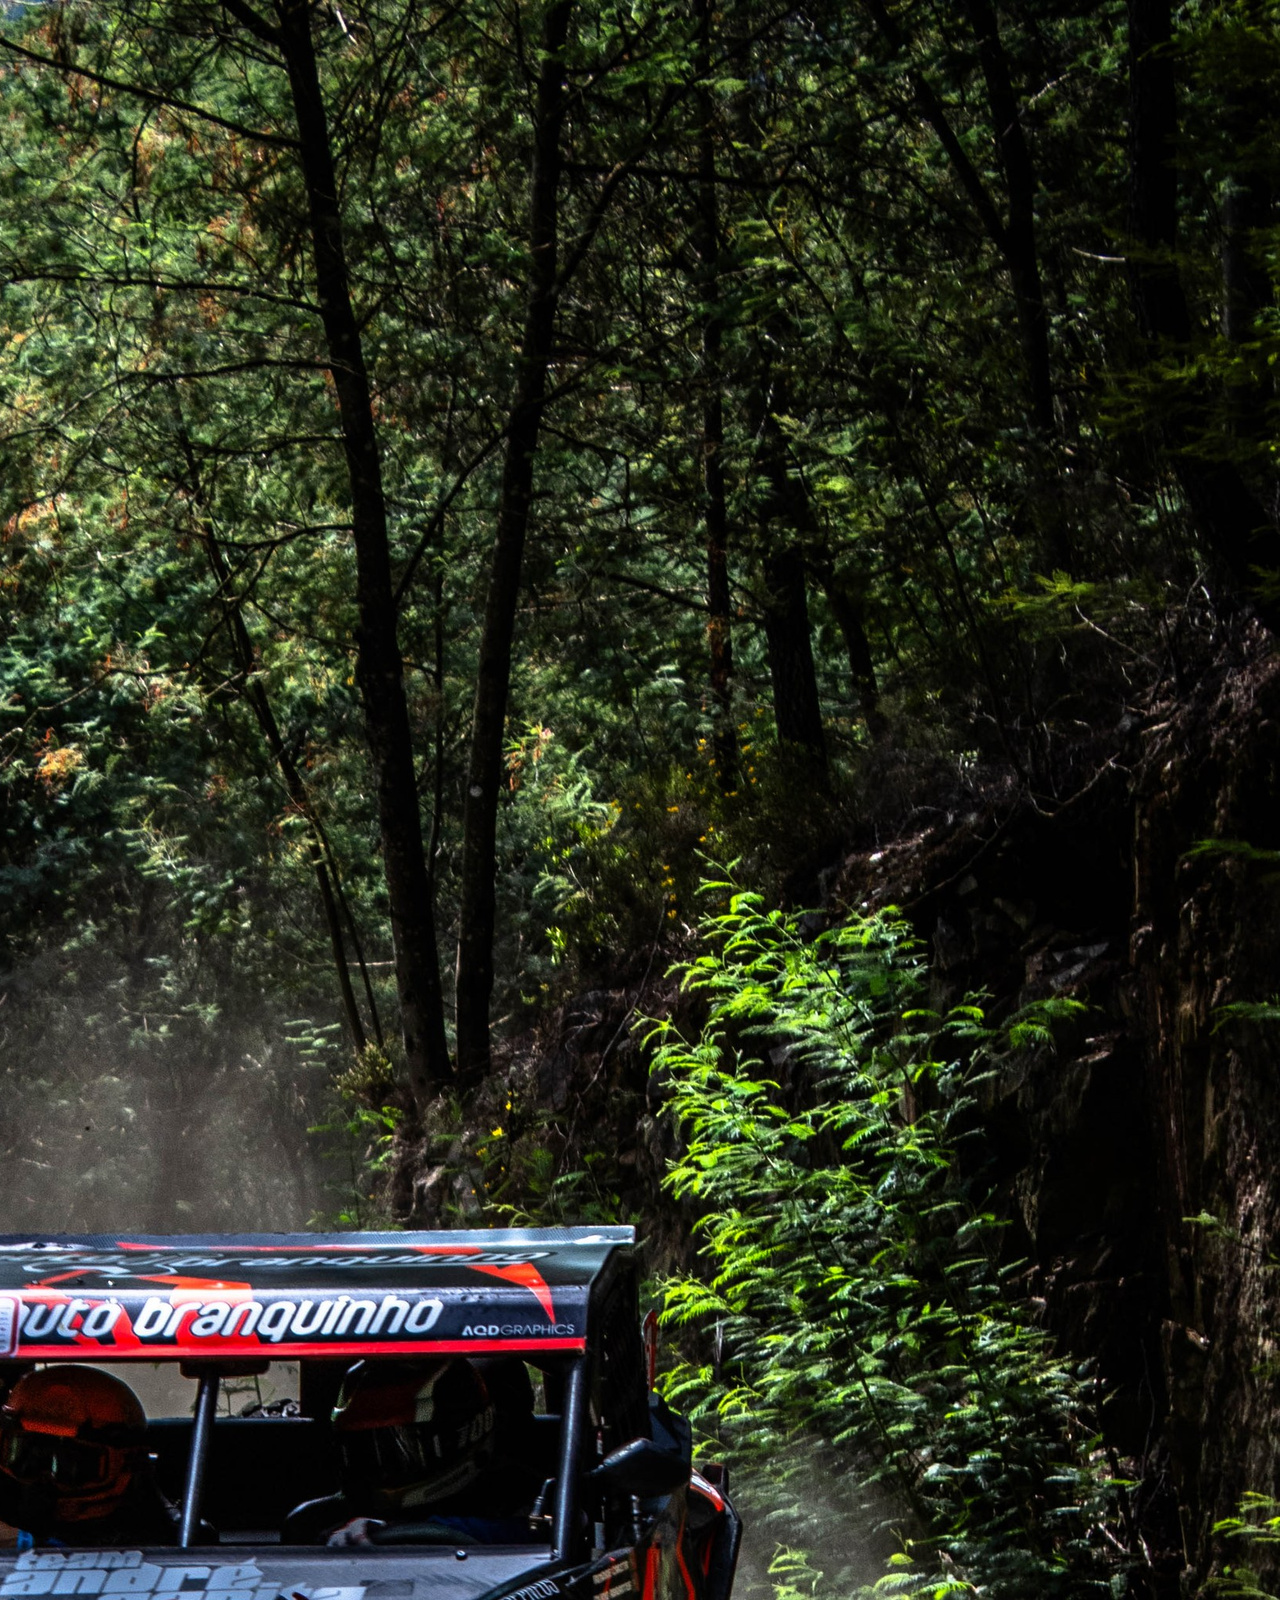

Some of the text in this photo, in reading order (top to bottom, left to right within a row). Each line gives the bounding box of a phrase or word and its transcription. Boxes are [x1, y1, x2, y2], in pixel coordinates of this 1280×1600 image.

[20, 1295, 444, 1342] uto branquinho
[15, 1549, 144, 1570] team
